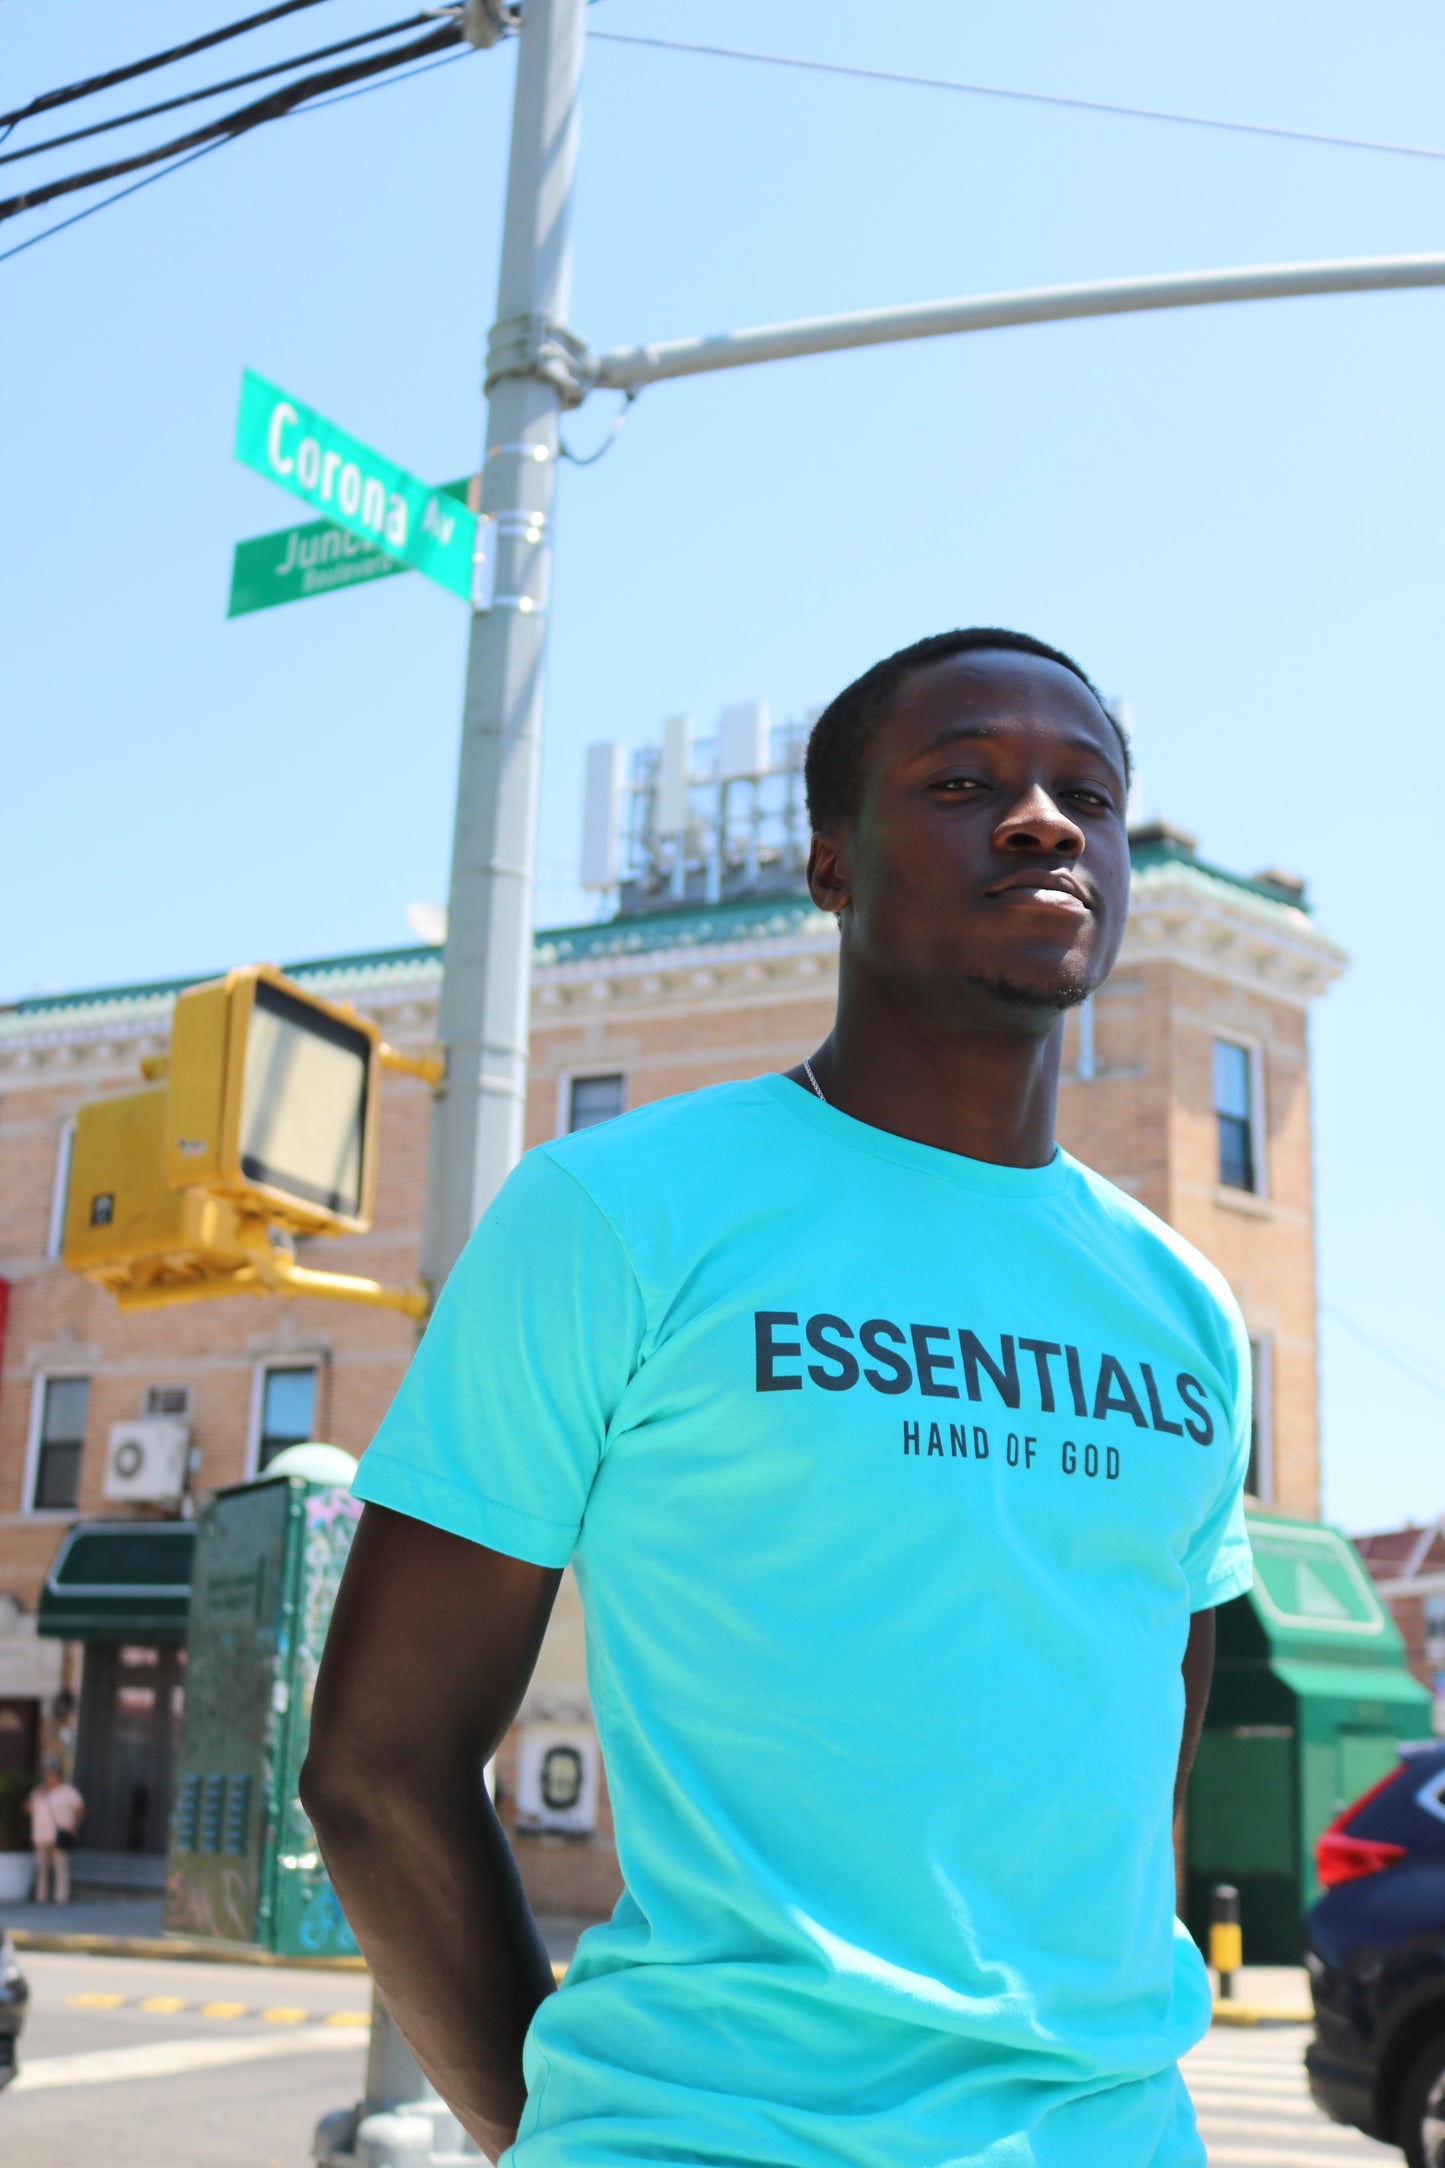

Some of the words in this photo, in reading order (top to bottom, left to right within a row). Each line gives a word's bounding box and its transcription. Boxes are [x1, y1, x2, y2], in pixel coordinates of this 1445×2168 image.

[268, 401, 408, 547] Corona
[423, 497, 455, 545] Av
[274, 530, 372, 575] Junc
[754, 1311, 1215, 1447] ESSENTIALS
[902, 1420, 990, 1460] HAND
[1006, 1433, 1038, 1469] OF
[1062, 1441, 1121, 1480] GOD
